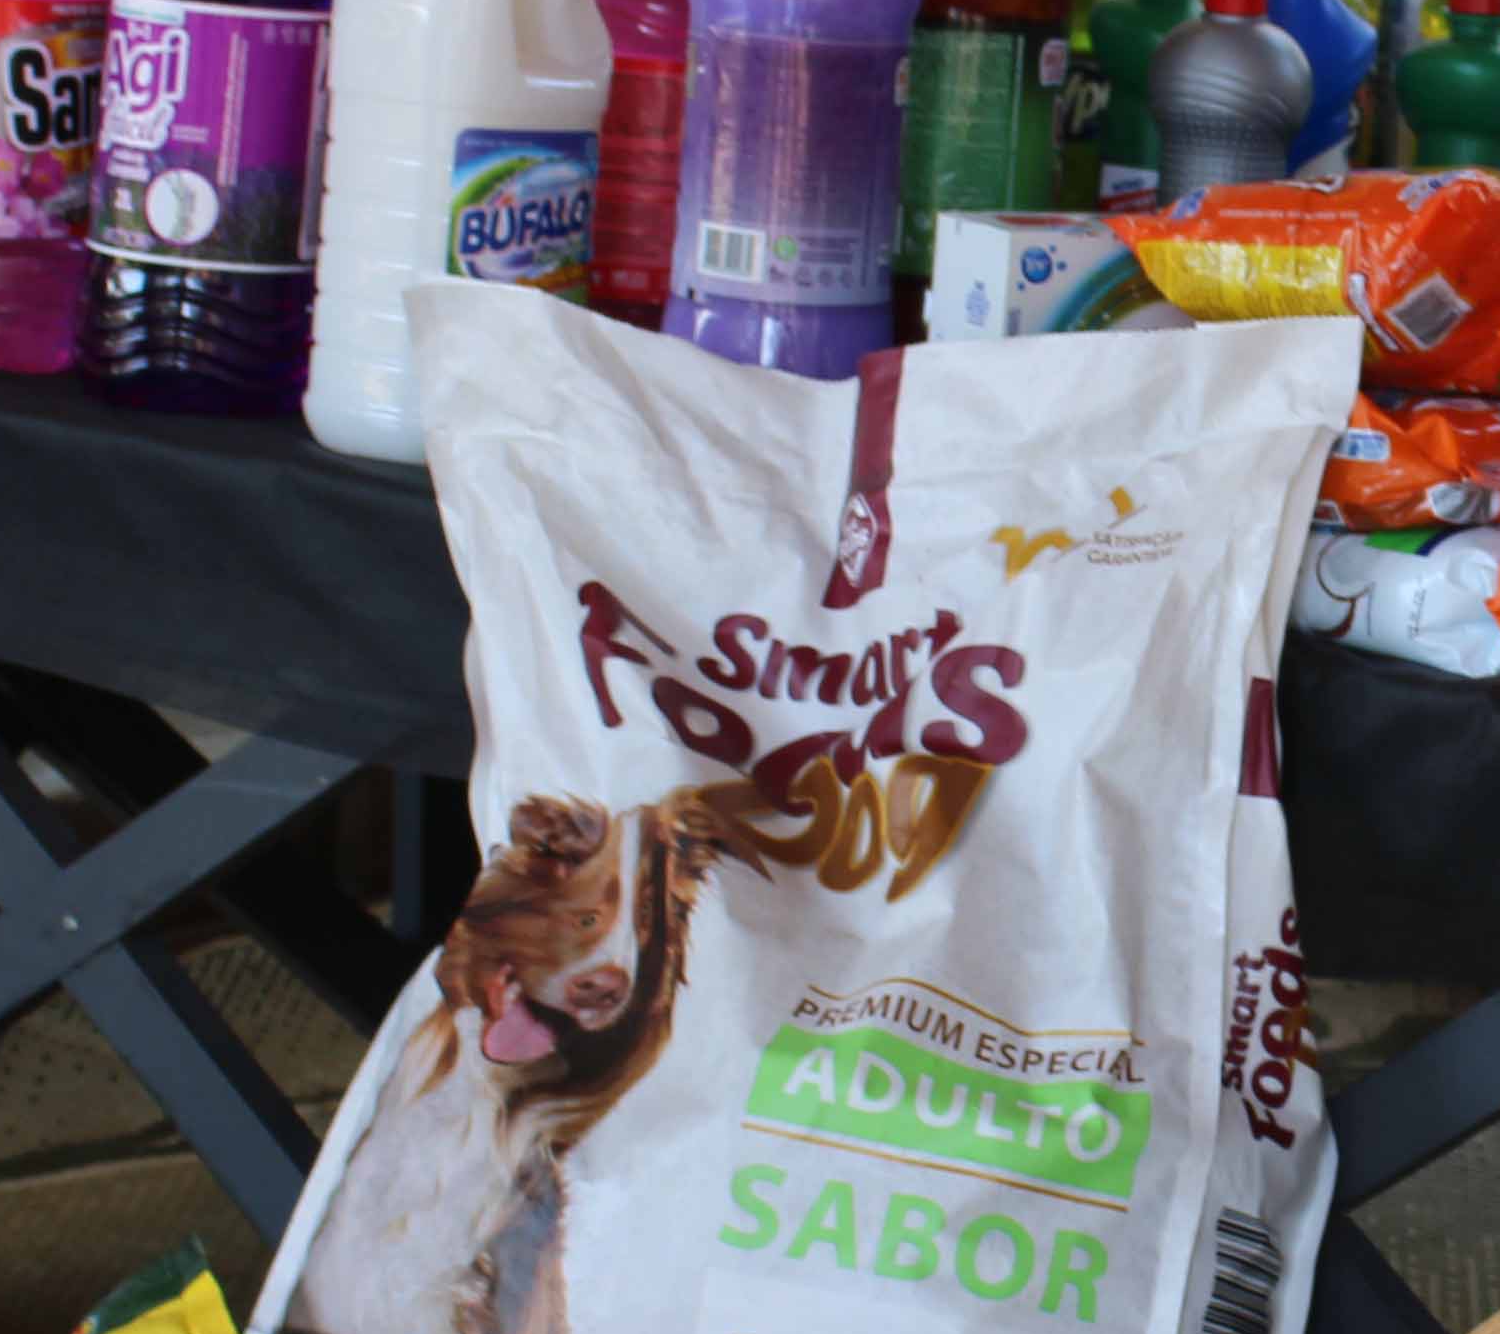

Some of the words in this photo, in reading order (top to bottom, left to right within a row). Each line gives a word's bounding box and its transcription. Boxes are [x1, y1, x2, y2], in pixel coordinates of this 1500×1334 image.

[792, 994, 965, 1052] PREMIUM
[974, 1033, 1145, 1085] ESPECIAL
[784, 1044, 1124, 1164] ADULTO
[716, 1162, 1109, 1325] SABOR
